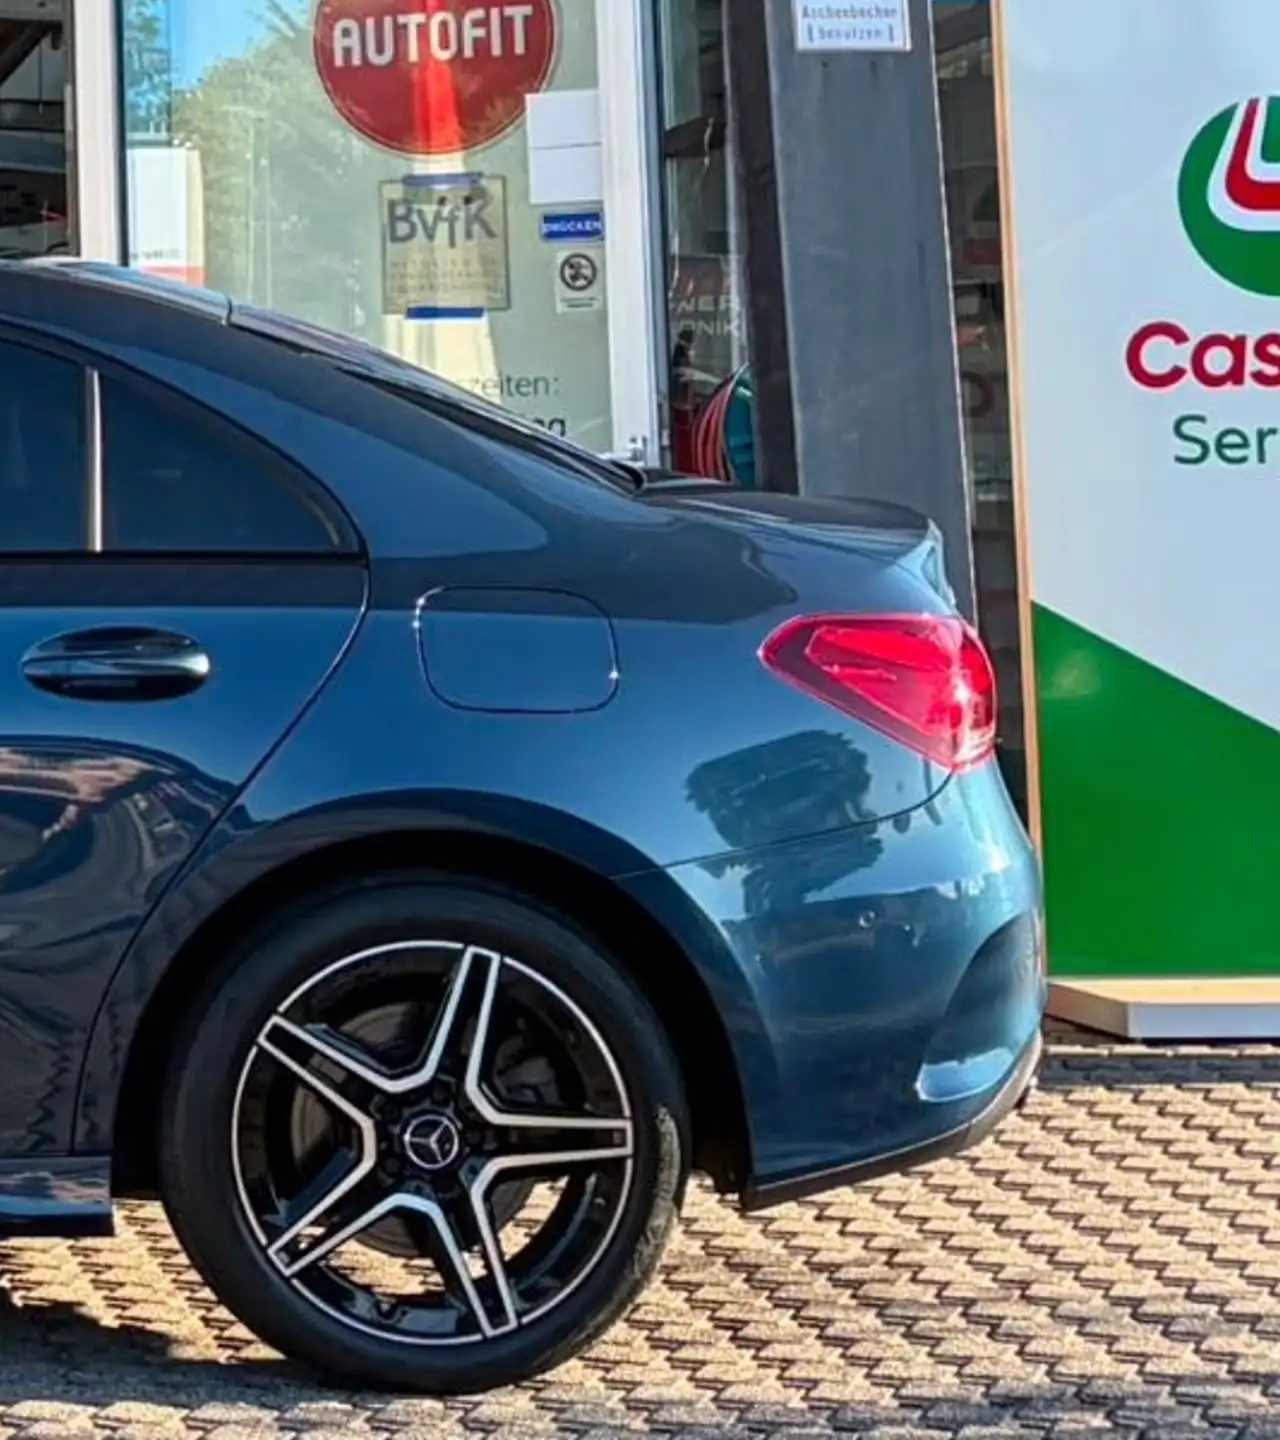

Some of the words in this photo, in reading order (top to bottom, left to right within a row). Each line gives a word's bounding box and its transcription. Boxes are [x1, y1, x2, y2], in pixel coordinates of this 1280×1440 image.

[333, 4, 533, 68] AUTOFIT
[1126, 320, 1280, 388] Cas
[1173, 413, 1280, 466] Ser
